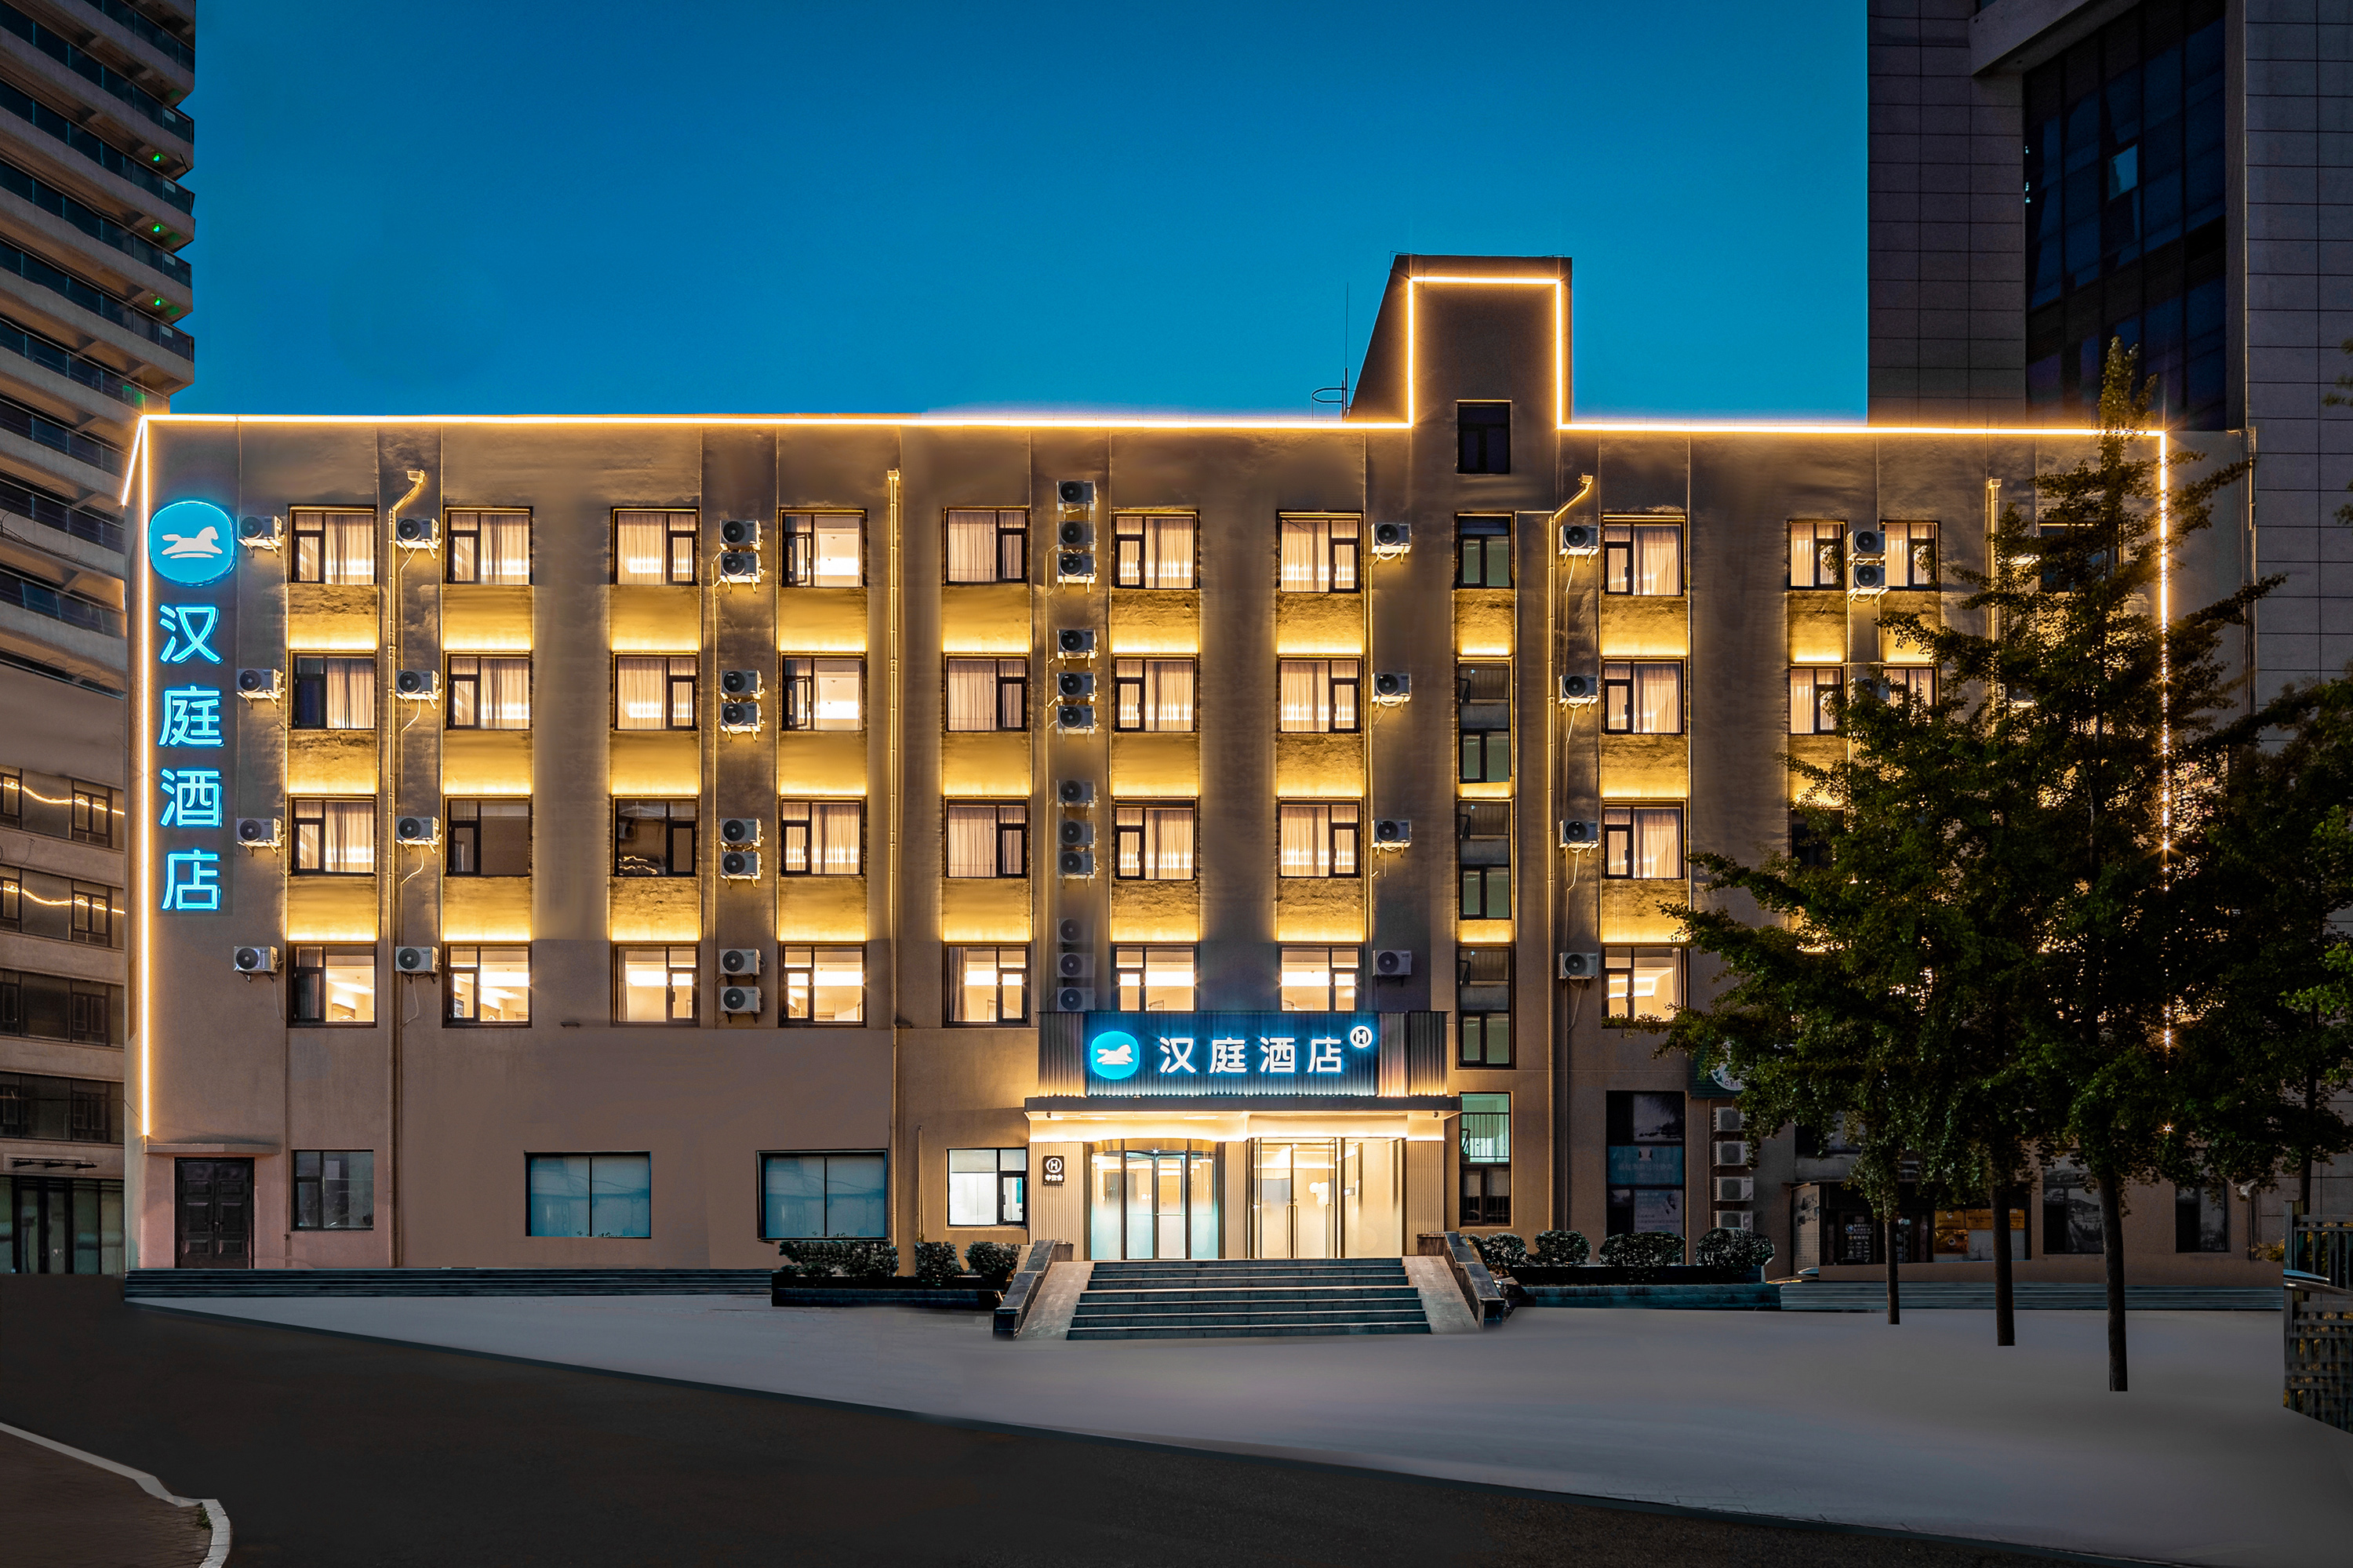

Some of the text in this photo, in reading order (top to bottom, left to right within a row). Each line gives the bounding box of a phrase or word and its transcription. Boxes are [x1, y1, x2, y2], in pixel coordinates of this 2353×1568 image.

[158, 604, 224, 911] 汉庭酒店
[1159, 1036, 1342, 1074] 汉庭酒店
